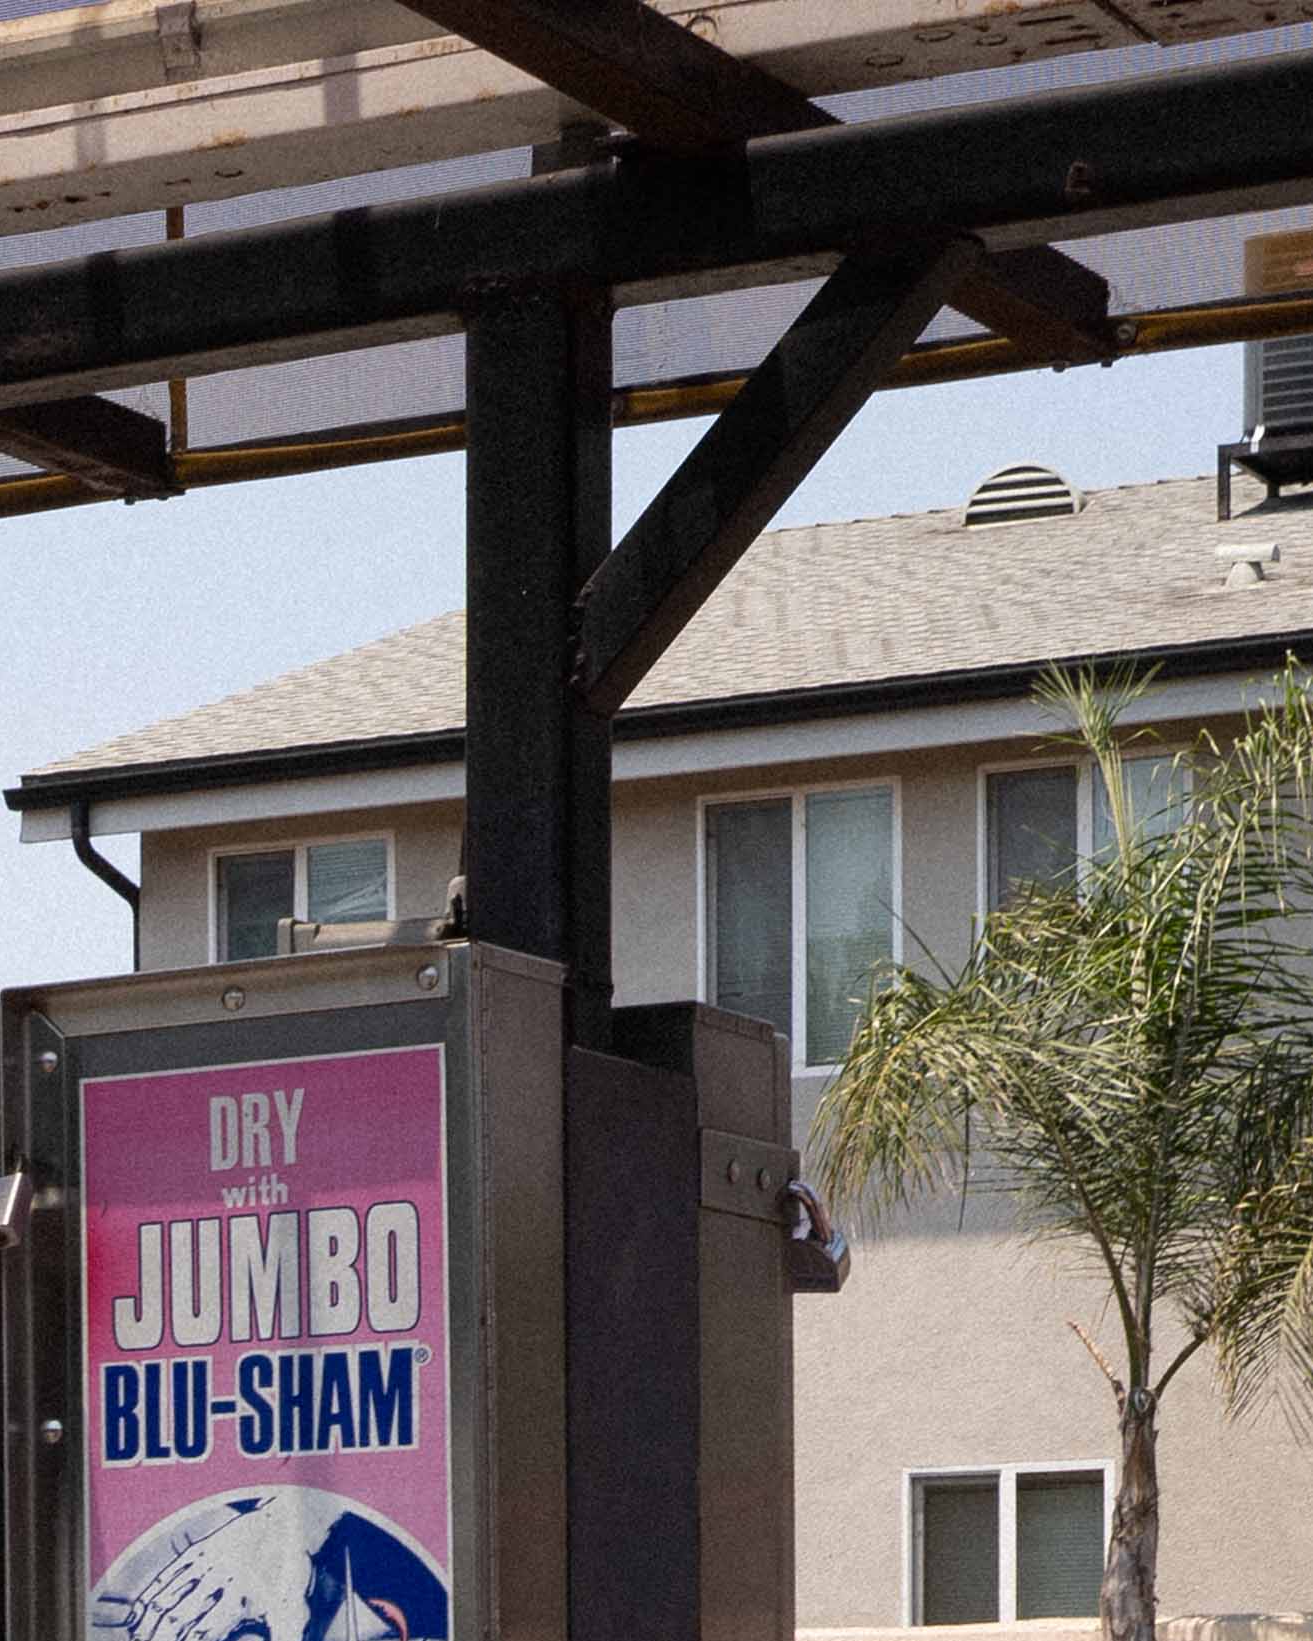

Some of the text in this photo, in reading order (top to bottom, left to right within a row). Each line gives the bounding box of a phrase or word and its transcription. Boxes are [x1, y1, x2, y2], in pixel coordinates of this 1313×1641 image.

[210, 1088, 305, 1170] DRY
[221, 1173, 288, 1209] with
[112, 1201, 420, 1350] JUMBO
[105, 1349, 417, 1463] BLU-SHAM
